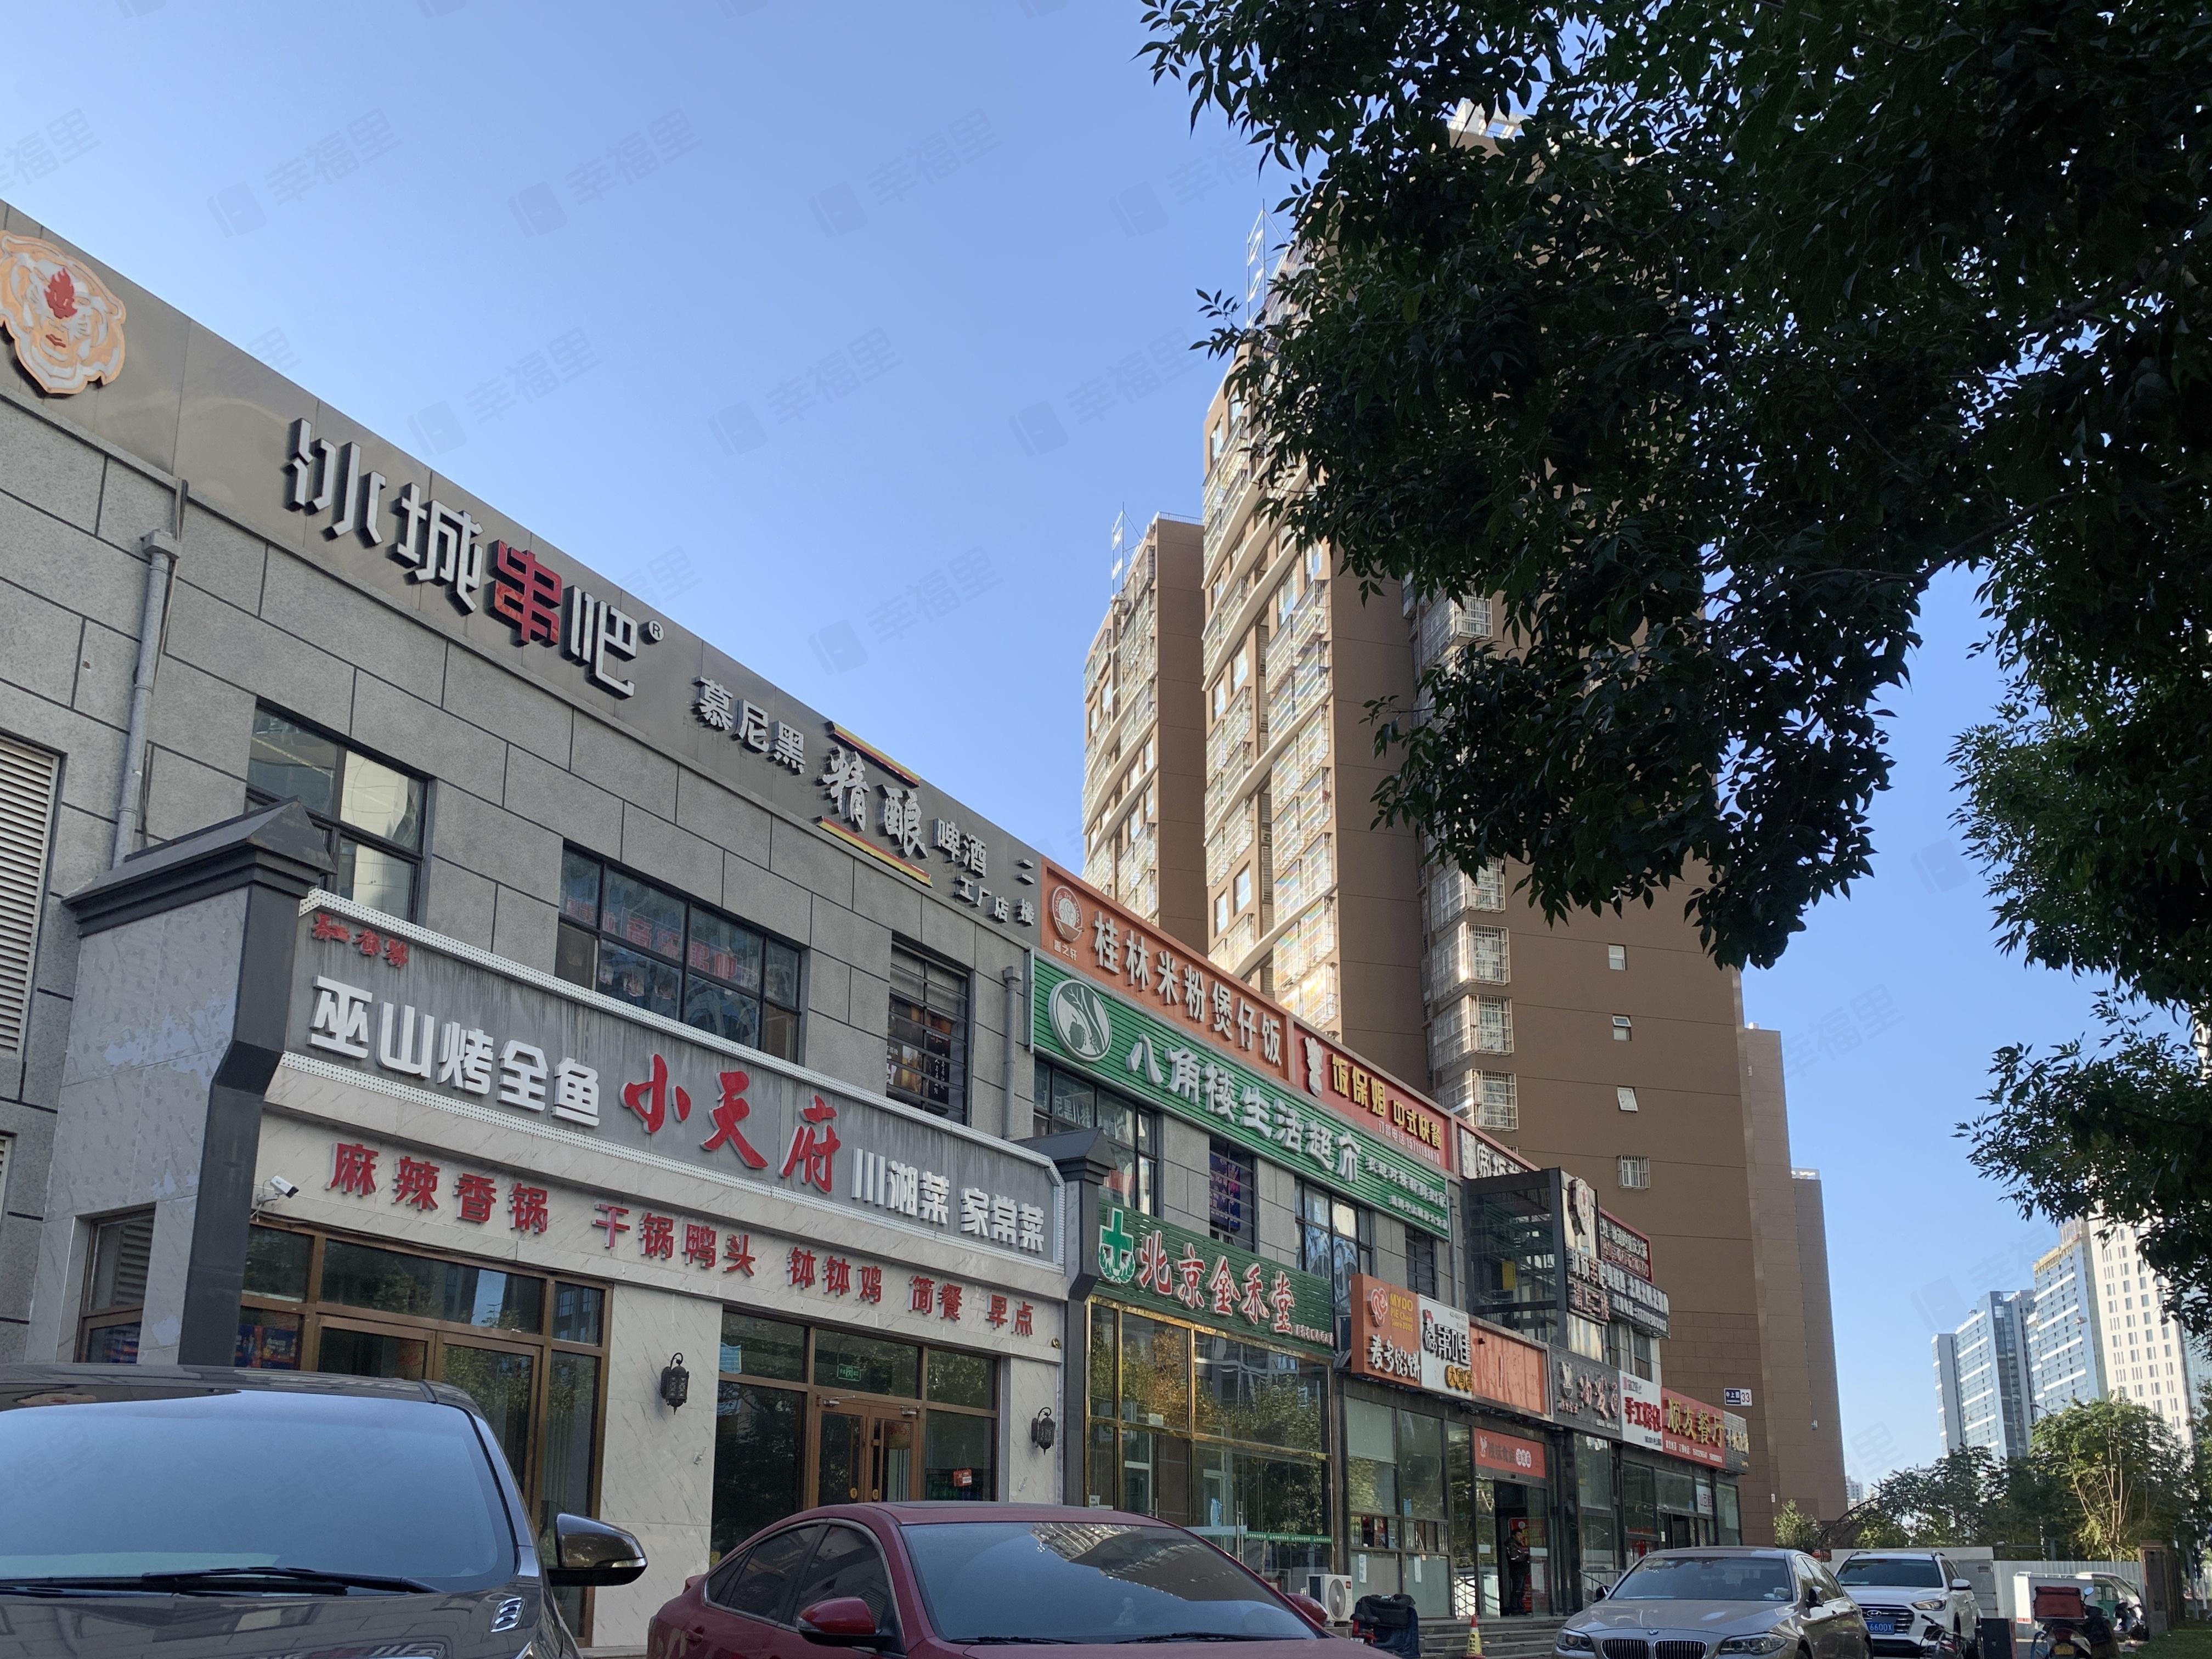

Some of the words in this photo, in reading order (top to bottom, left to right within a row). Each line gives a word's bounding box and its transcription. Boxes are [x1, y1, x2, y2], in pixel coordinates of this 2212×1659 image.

[284, 417, 637, 699] 冰城串吧
[692, 675, 805, 775] 慕尼黑
[818, 746, 928, 858] 精酿
[934, 818, 988, 878] 啤酒
[954, 875, 1009, 923] 工厂店
[1092, 911, 1282, 1068] 桂林米粉煲仔饭
[307, 975, 600, 1126] 巫山烤全鱼
[619, 1053, 841, 1193] 小天府
[850, 1147, 950, 1226] 川湘菜
[959, 1187, 1045, 1252] 家常菜
[1126, 1033, 1361, 1182] 八角楼生活超市
[1331, 1053, 1386, 1117] 饭保姆
[1393, 1099, 1441, 1149] 中式快餐
[327, 1143, 549, 1234] 麻辣香锅
[591, 1203, 756, 1277] 干锅鸭头
[787, 1246, 882, 1304] 钵钵鸡
[909, 1274, 962, 1321] 简餐
[986, 1295, 1034, 1336] 早点
[1135, 1230, 1295, 1334] 北京金禾堂
[1390, 1293, 1413, 1311] MYDO
[1667, 1397, 1725, 1448] 顺友餐厅
[1741, 1392, 1751, 1403] 33
